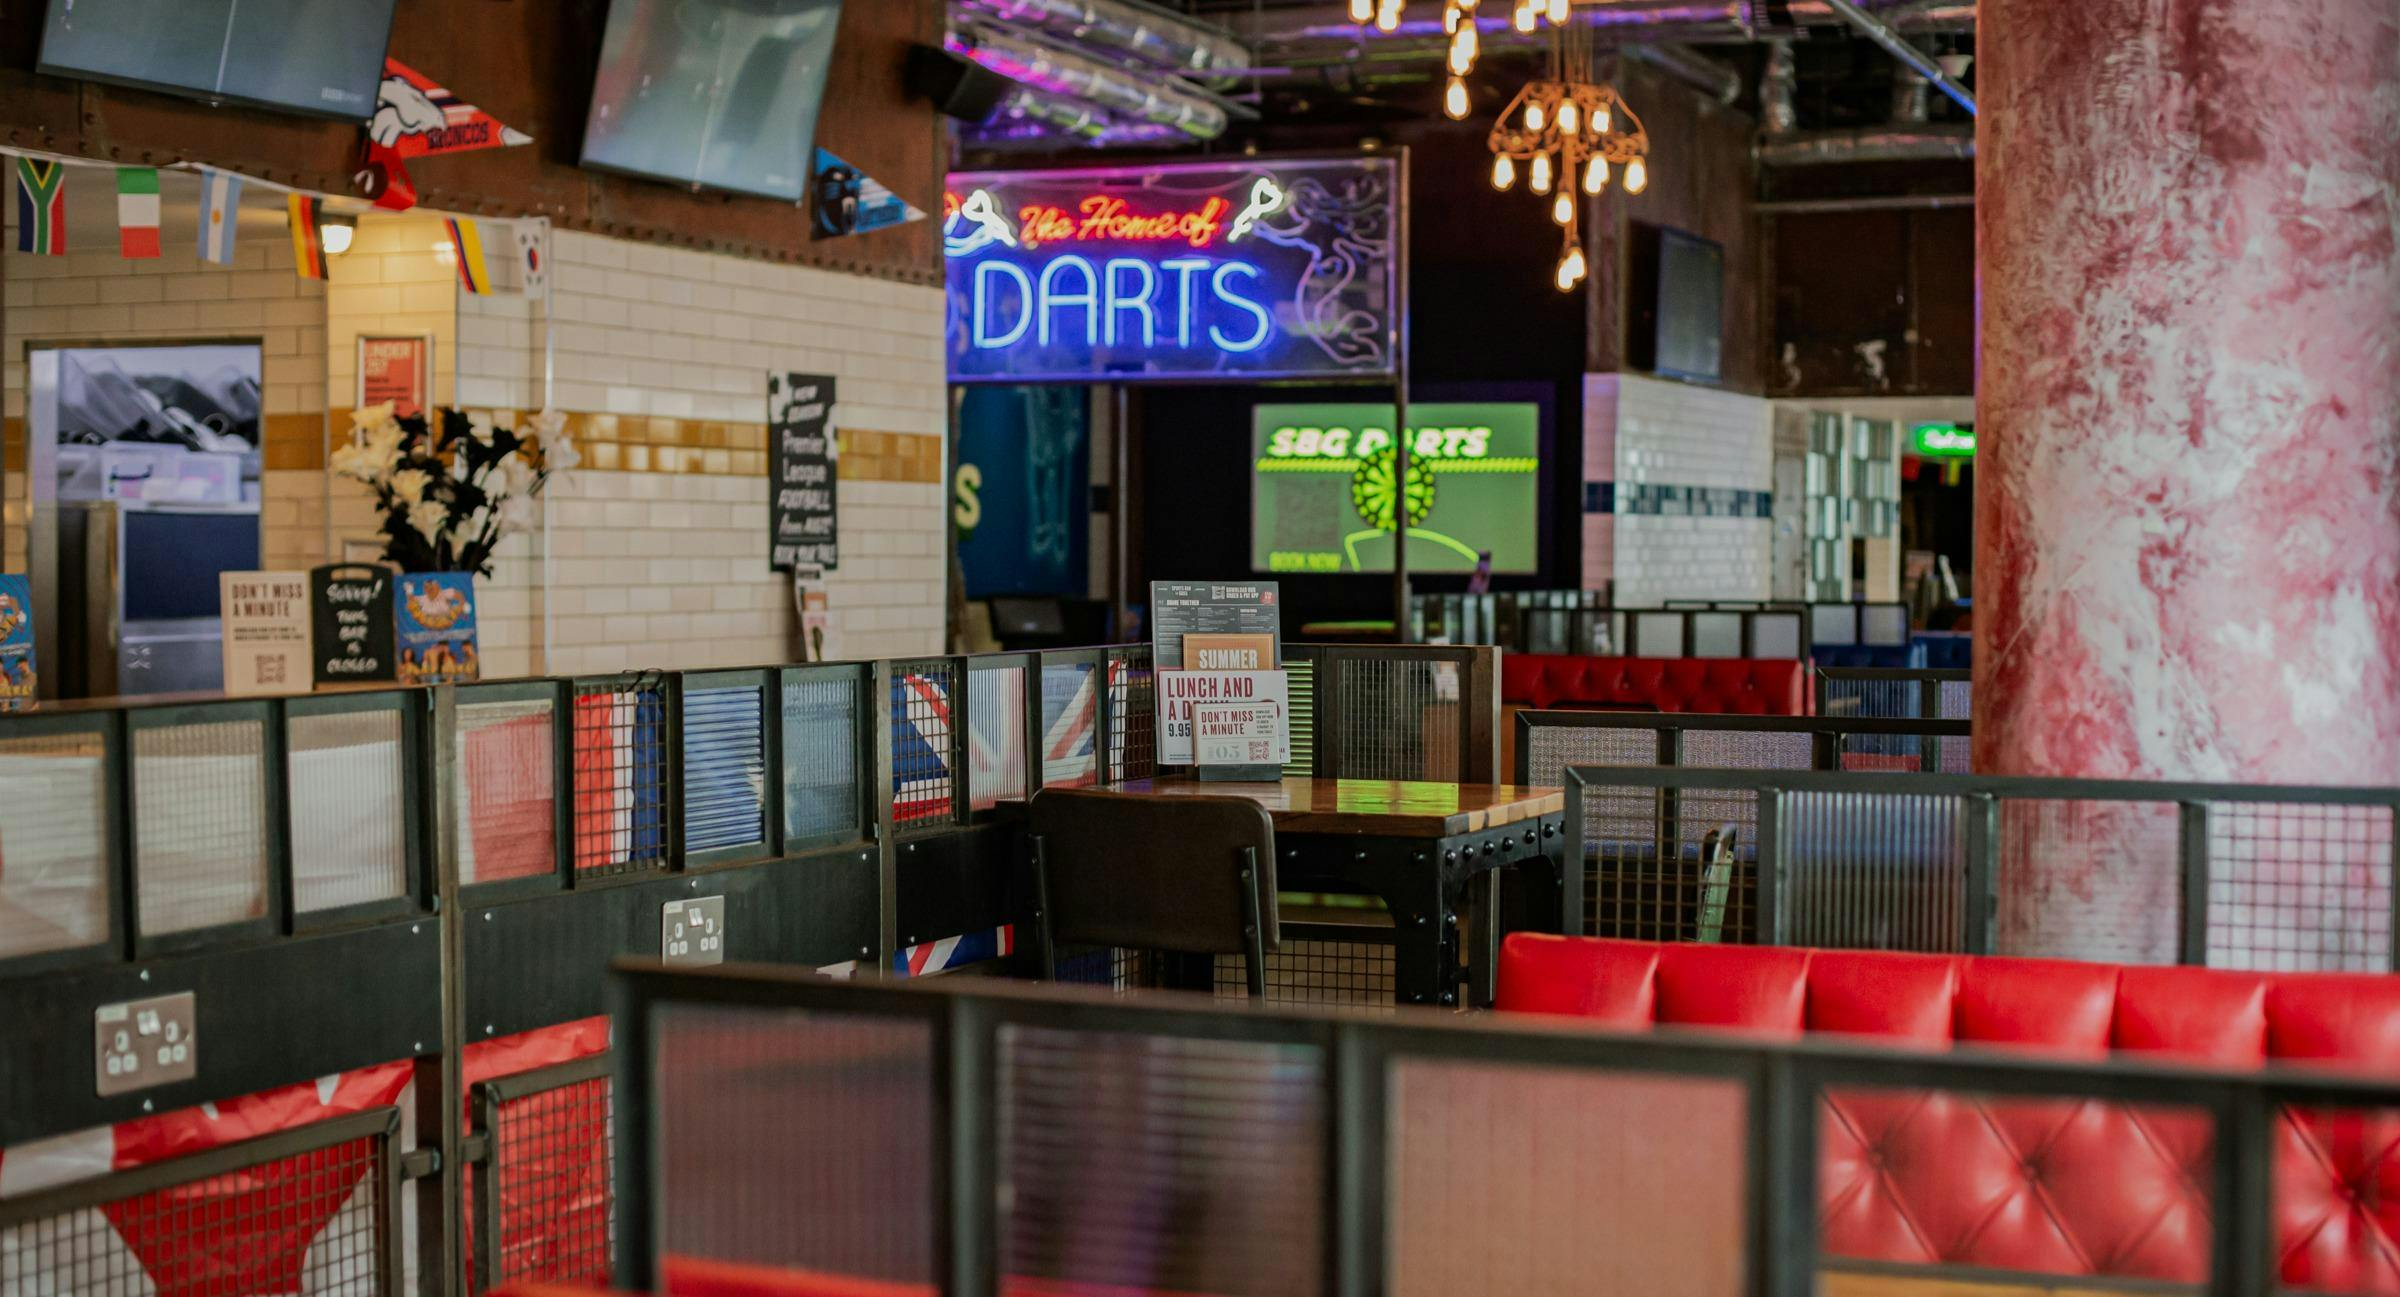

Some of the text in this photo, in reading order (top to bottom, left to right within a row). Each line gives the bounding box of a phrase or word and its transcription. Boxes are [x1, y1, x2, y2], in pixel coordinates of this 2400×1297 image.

[428, 122, 489, 149] BRONCOS
[1018, 195, 1229, 247] The Home of
[973, 254, 1270, 352] DARTS
[782, 430, 825, 455] Premier
[1267, 427, 1352, 457] SBG
[782, 457, 828, 487] League
[777, 489, 832, 511] FOOTBALL
[1269, 552, 1342, 572] BOOK NOW
[232, 583, 303, 599] DON'T MISS
[232, 601, 290, 617] A MINUTE
[1199, 649, 1258, 670] SUMMER
[1167, 677, 1253, 698] LUNCH AND
[1168, 700, 1177, 720] A
[1201, 710, 1228, 723] DON'T
[1231, 710, 1254, 722] MISS
[1168, 723, 1191, 737] 9.95
[1202, 723, 1245, 736] A MINUTE
